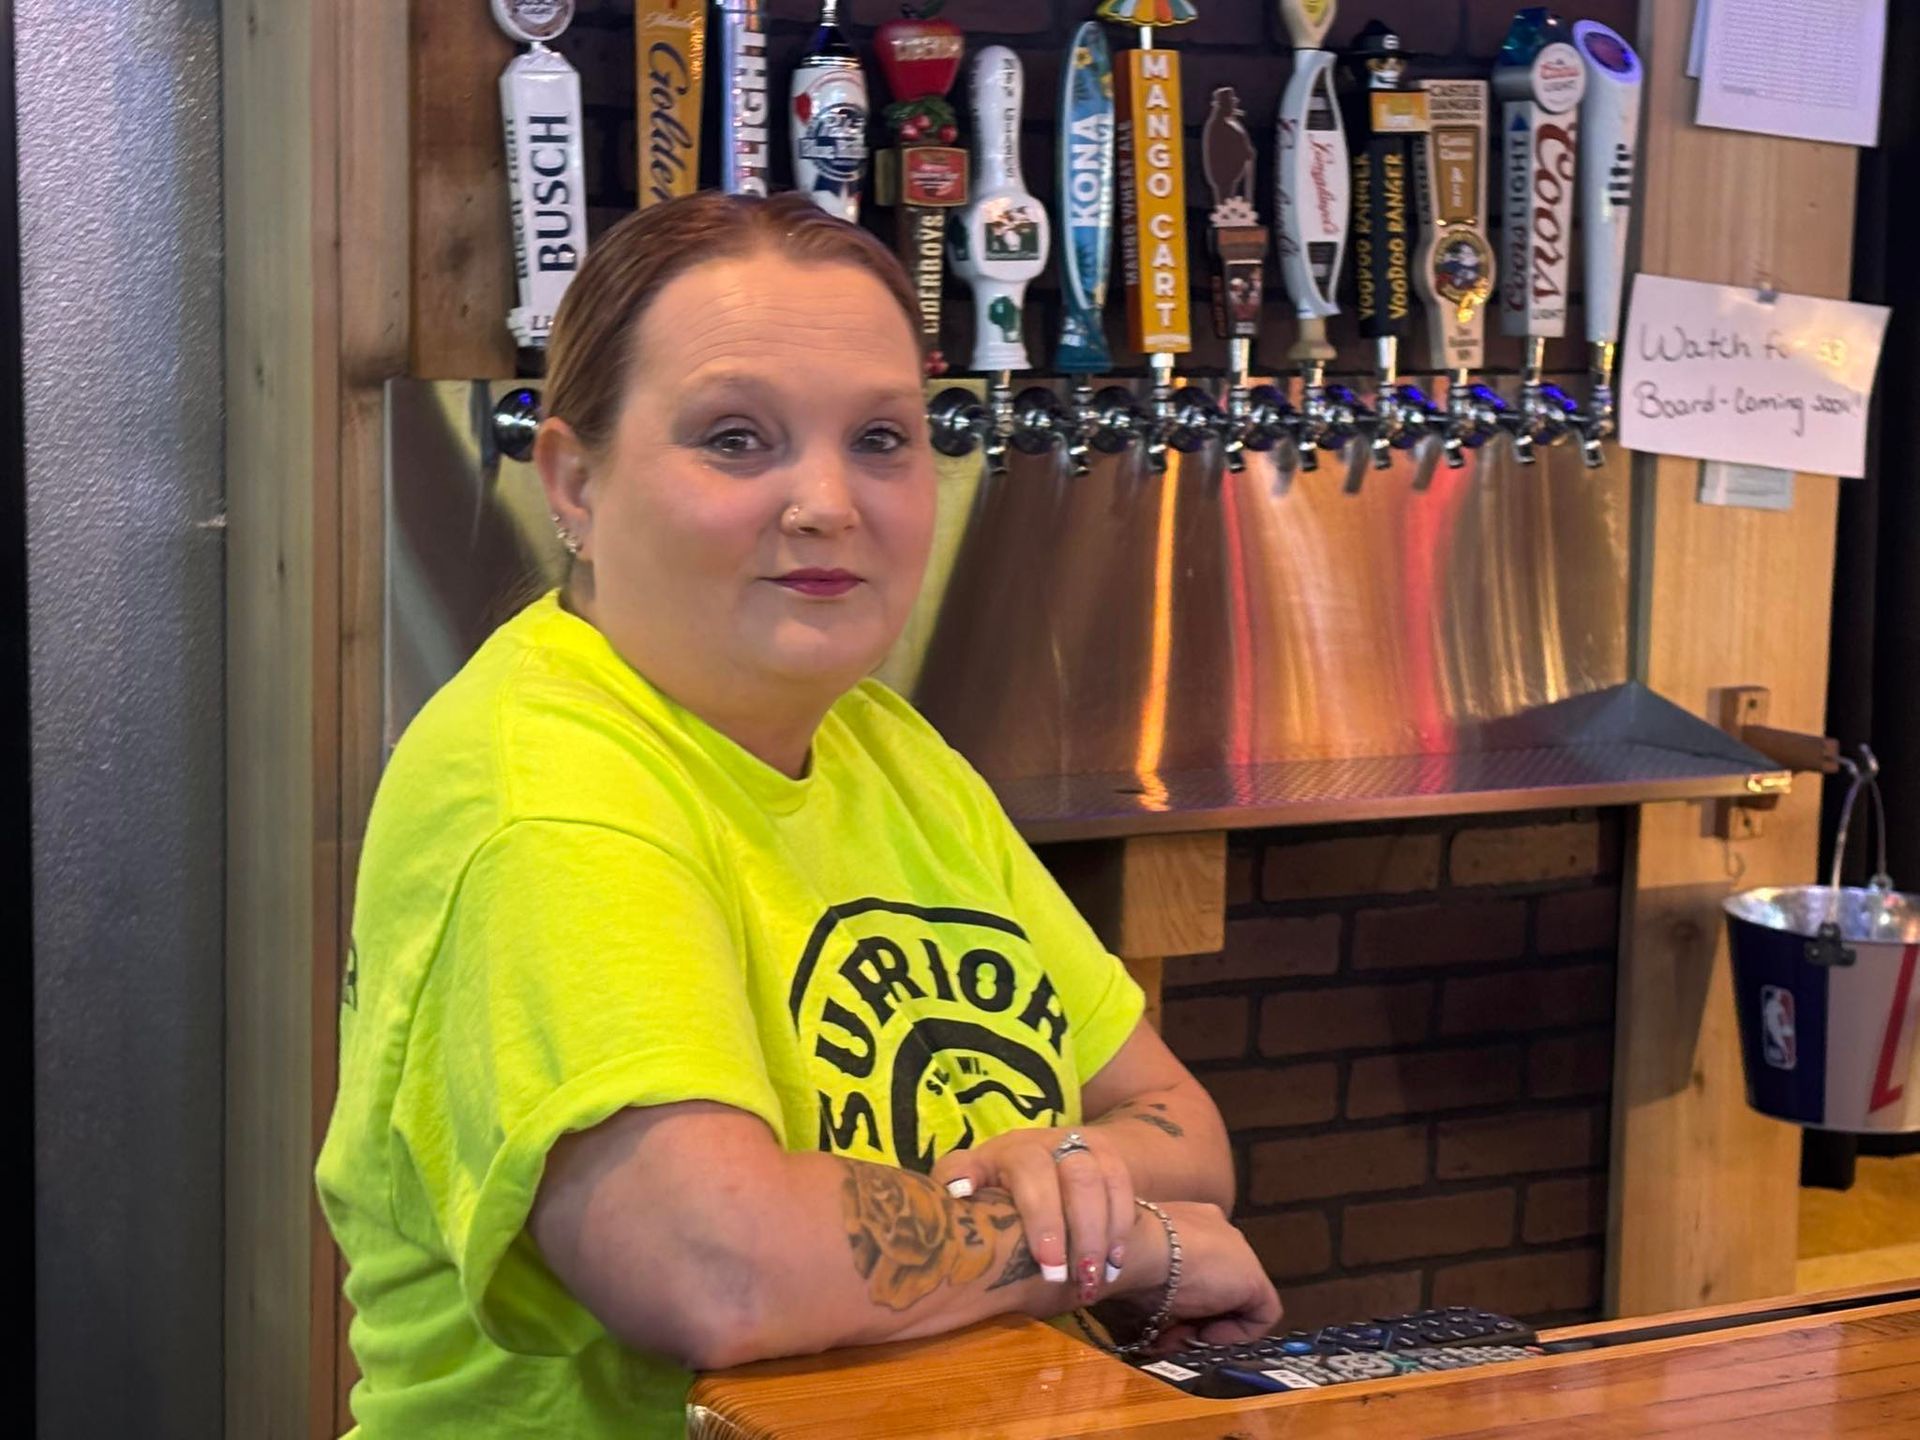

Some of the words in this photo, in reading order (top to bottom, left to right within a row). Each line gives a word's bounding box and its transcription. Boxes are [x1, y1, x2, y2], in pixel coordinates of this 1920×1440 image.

[736, 25, 768, 169] LIGHT
[1142, 55, 1172, 198] MANGO
[529, 115, 578, 272] BUSCH
[1070, 114, 1100, 227] KONA
[1383, 153, 1405, 233] RANGER
[1510, 136, 1528, 218] LIGHT
[1532, 122, 1577, 303] Coors
[917, 215, 945, 334] CIDERBOYS
[1150, 213, 1176, 328] CART
[1385, 238, 1409, 320] VOODOO
[1502, 225, 1526, 312] Coors
[1640, 324, 1751, 362] Watch
